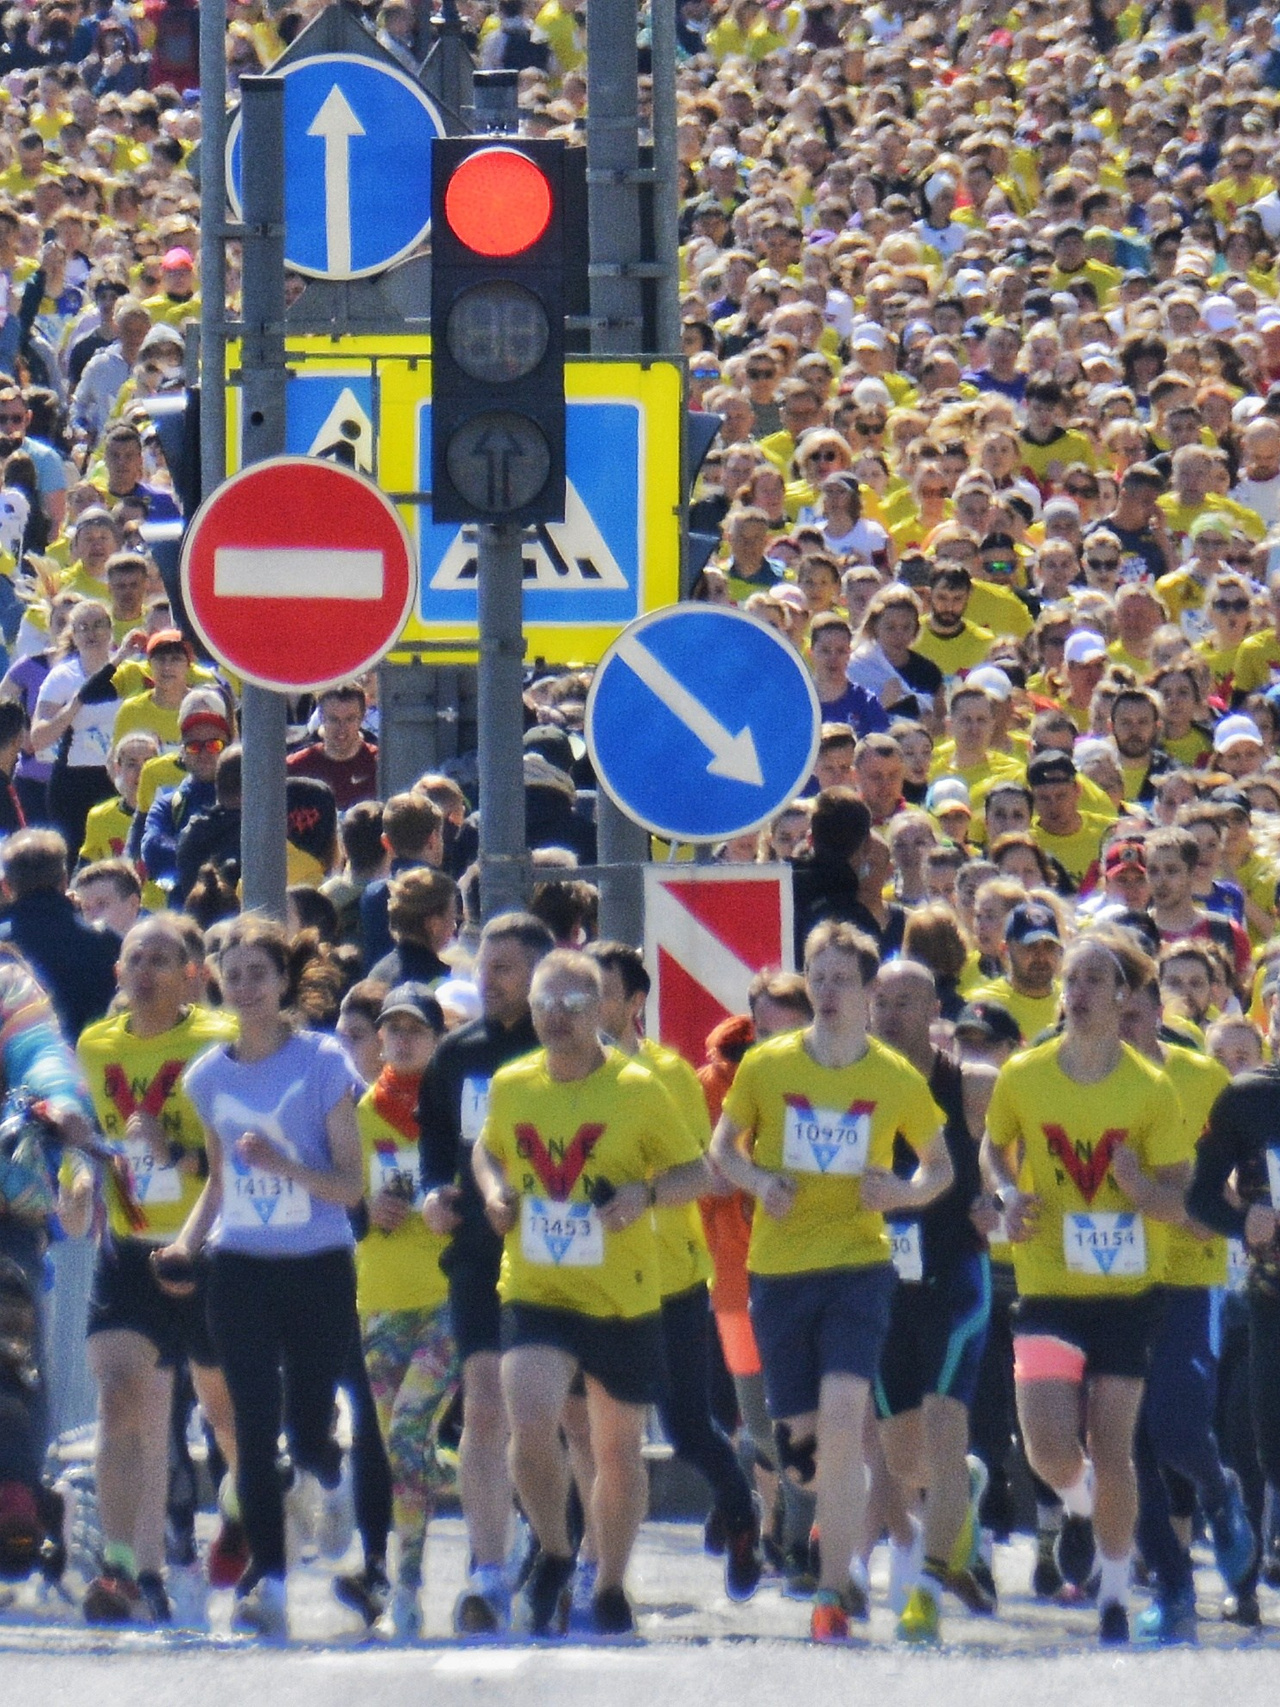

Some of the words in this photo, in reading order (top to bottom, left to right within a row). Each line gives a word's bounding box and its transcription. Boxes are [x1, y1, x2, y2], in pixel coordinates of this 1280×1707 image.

[795, 1122, 858, 1145] 10970
[235, 1176, 294, 1195] 14131
[1075, 1230, 1135, 1247] 14154
